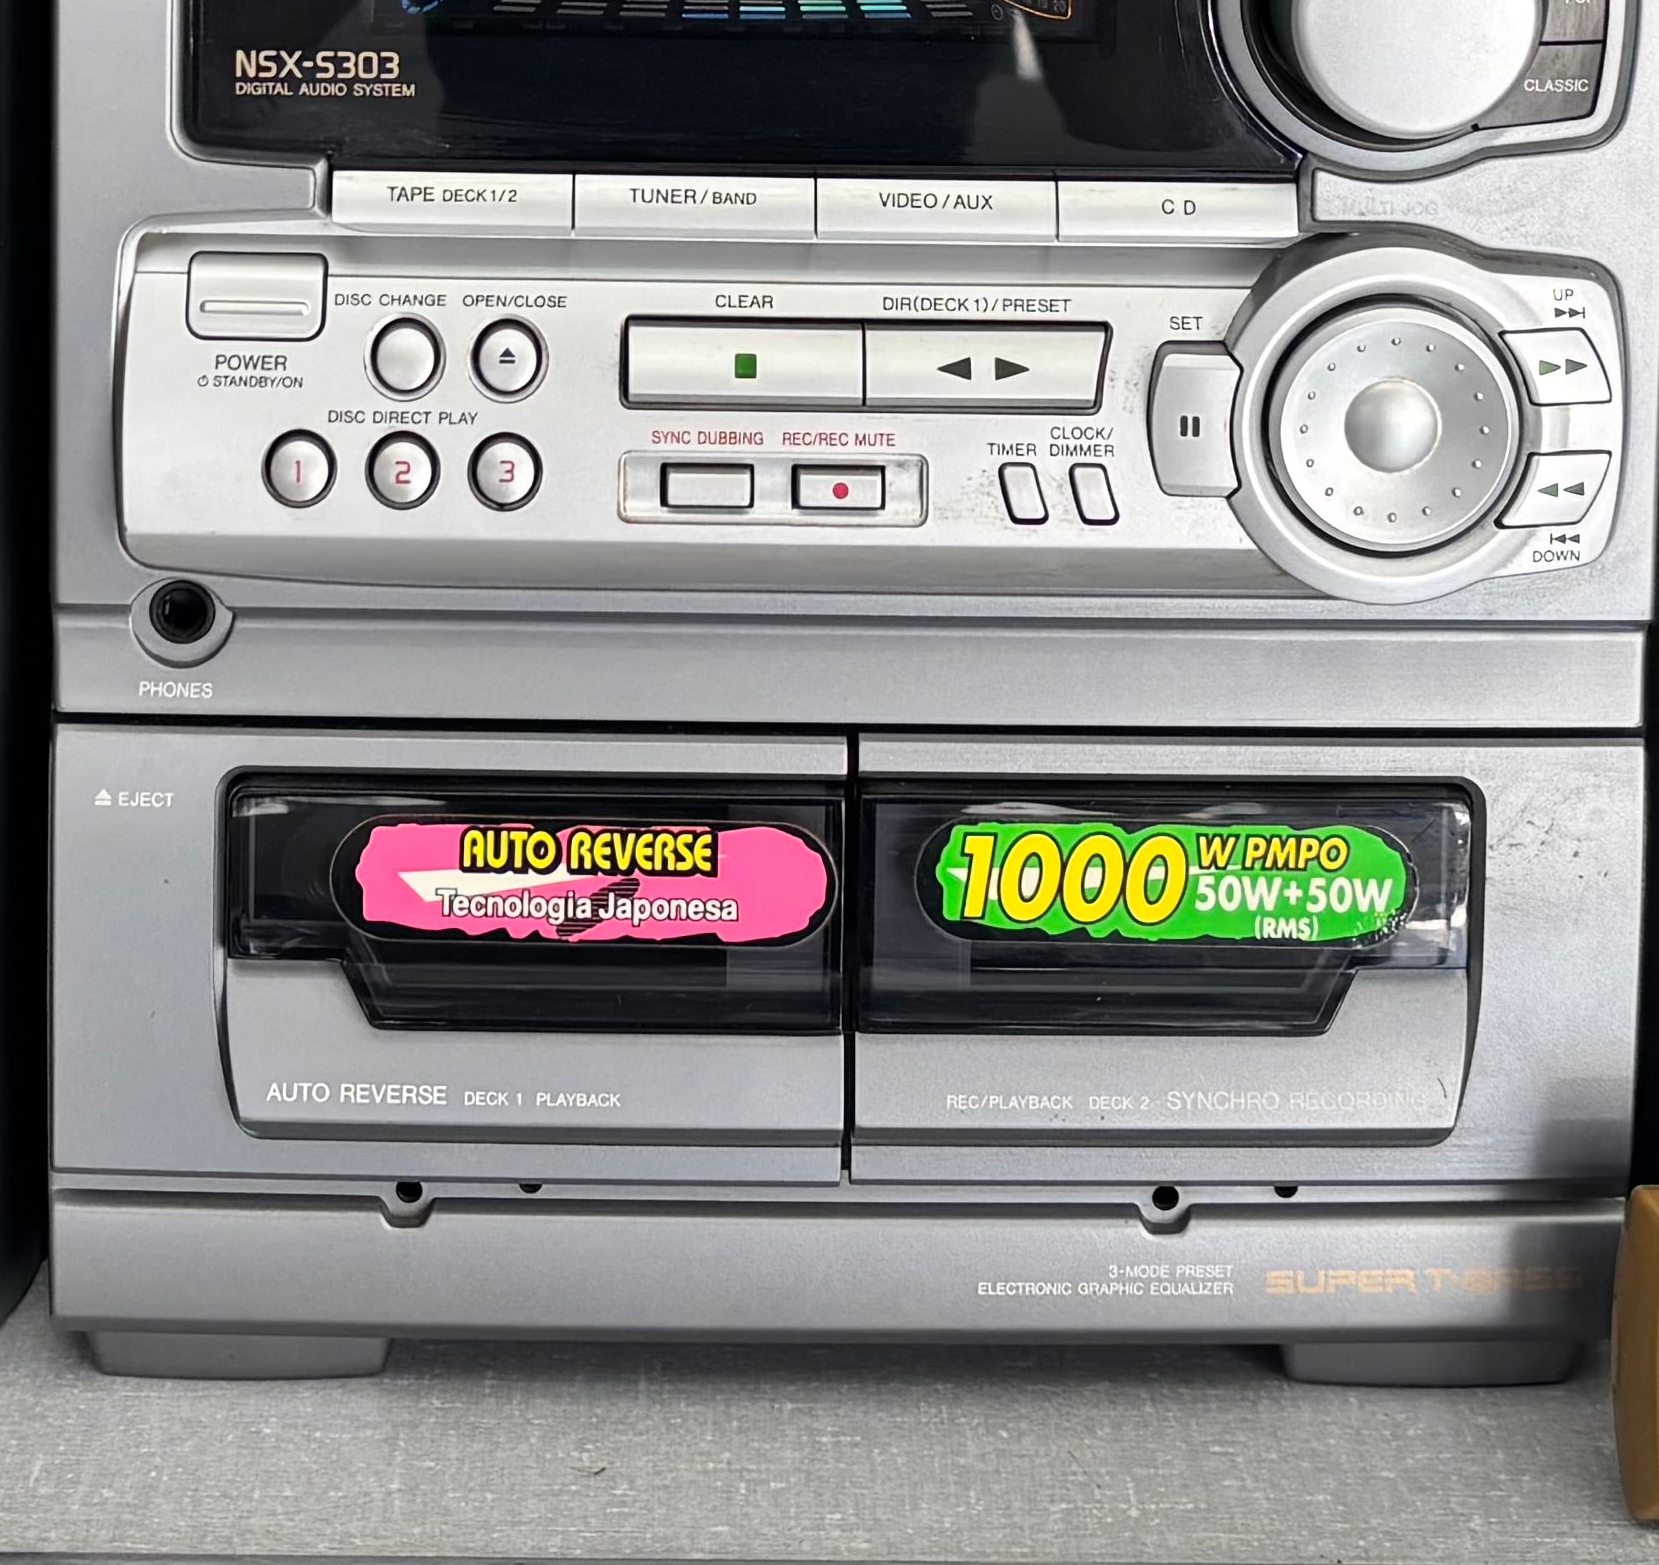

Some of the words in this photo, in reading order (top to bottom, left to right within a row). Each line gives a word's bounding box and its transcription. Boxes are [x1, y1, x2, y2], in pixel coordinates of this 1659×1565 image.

[234, 49, 401, 80] NSX-S303
[234, 82, 294, 96] DIGITAL
[298, 82, 348, 97] AUDIO
[352, 83, 416, 98] SYSTEM
[1523, 78, 1590, 94] CLASSIC
[386, 185, 436, 203] TAPE
[333, 293, 372, 308] DISC
[378, 293, 448, 308] CHANGE
[461, 294, 568, 309] OPEN/CLOSE
[714, 294, 775, 310] CLEAR
[1552, 288, 1576, 302] UP
[1168, 316, 1204, 332] SET
[214, 354, 289, 372] POWER
[212, 375, 304, 389] STANDBY/ON
[327, 410, 367, 424] DISC
[371, 410, 433, 425] DIRECT
[438, 411, 479, 426] PLAY
[650, 429, 694, 446] SYNC
[696, 430, 765, 447] DUBBING
[781, 430, 850, 448] REC/REC
[853, 431, 897, 448] MUTE
[1049, 426, 1115, 441] CLOCK/
[986, 442, 1038, 458] TIMER
[1048, 443, 1116, 459] DIMMER
[295, 459, 302, 484] 1
[394, 460, 412, 485] 2
[498, 460, 516, 484] 3
[1532, 549, 1582, 564] DOWN
[138, 680, 214, 699] PHONES
[117, 791, 175, 808] EJECT
[461, 828, 558, 871] AUTO
[568, 830, 714, 873] REVERSE
[1197, 835, 1235, 870] W
[1244, 836, 1349, 872] PMPO
[960, 831, 1189, 925] 1000
[1194, 874, 1394, 914] 50W+50W
[435, 887, 593, 926] Tecnologia
[597, 890, 740, 928] Japonesa
[1253, 914, 1320, 941] (RMS)
[266, 1082, 331, 1104] AUTO
[339, 1083, 448, 1106] REVERSE
[463, 1091, 509, 1107] DECK
[515, 1092, 523, 1106] 1
[535, 1092, 622, 1108] PLAYBACK
[946, 1094, 1074, 1110] REC/PLAYBACK
[1088, 1095, 1134, 1110] DECK
[1139, 1096, 1150, 1110] 2
[1165, 1090, 1281, 1111] SYNCHRO
[1288, 1091, 1428, 1112] RECORDING
[1108, 1264, 1172, 1279] 3-MODE
[1175, 1264, 1235, 1279] PRESET
[977, 1282, 1073, 1297] ELECTRONIC
[1077, 1282, 1145, 1297] GRAPHIC
[1149, 1282, 1235, 1297] EQUALIZER
[1264, 1270, 1416, 1297] SUPER
